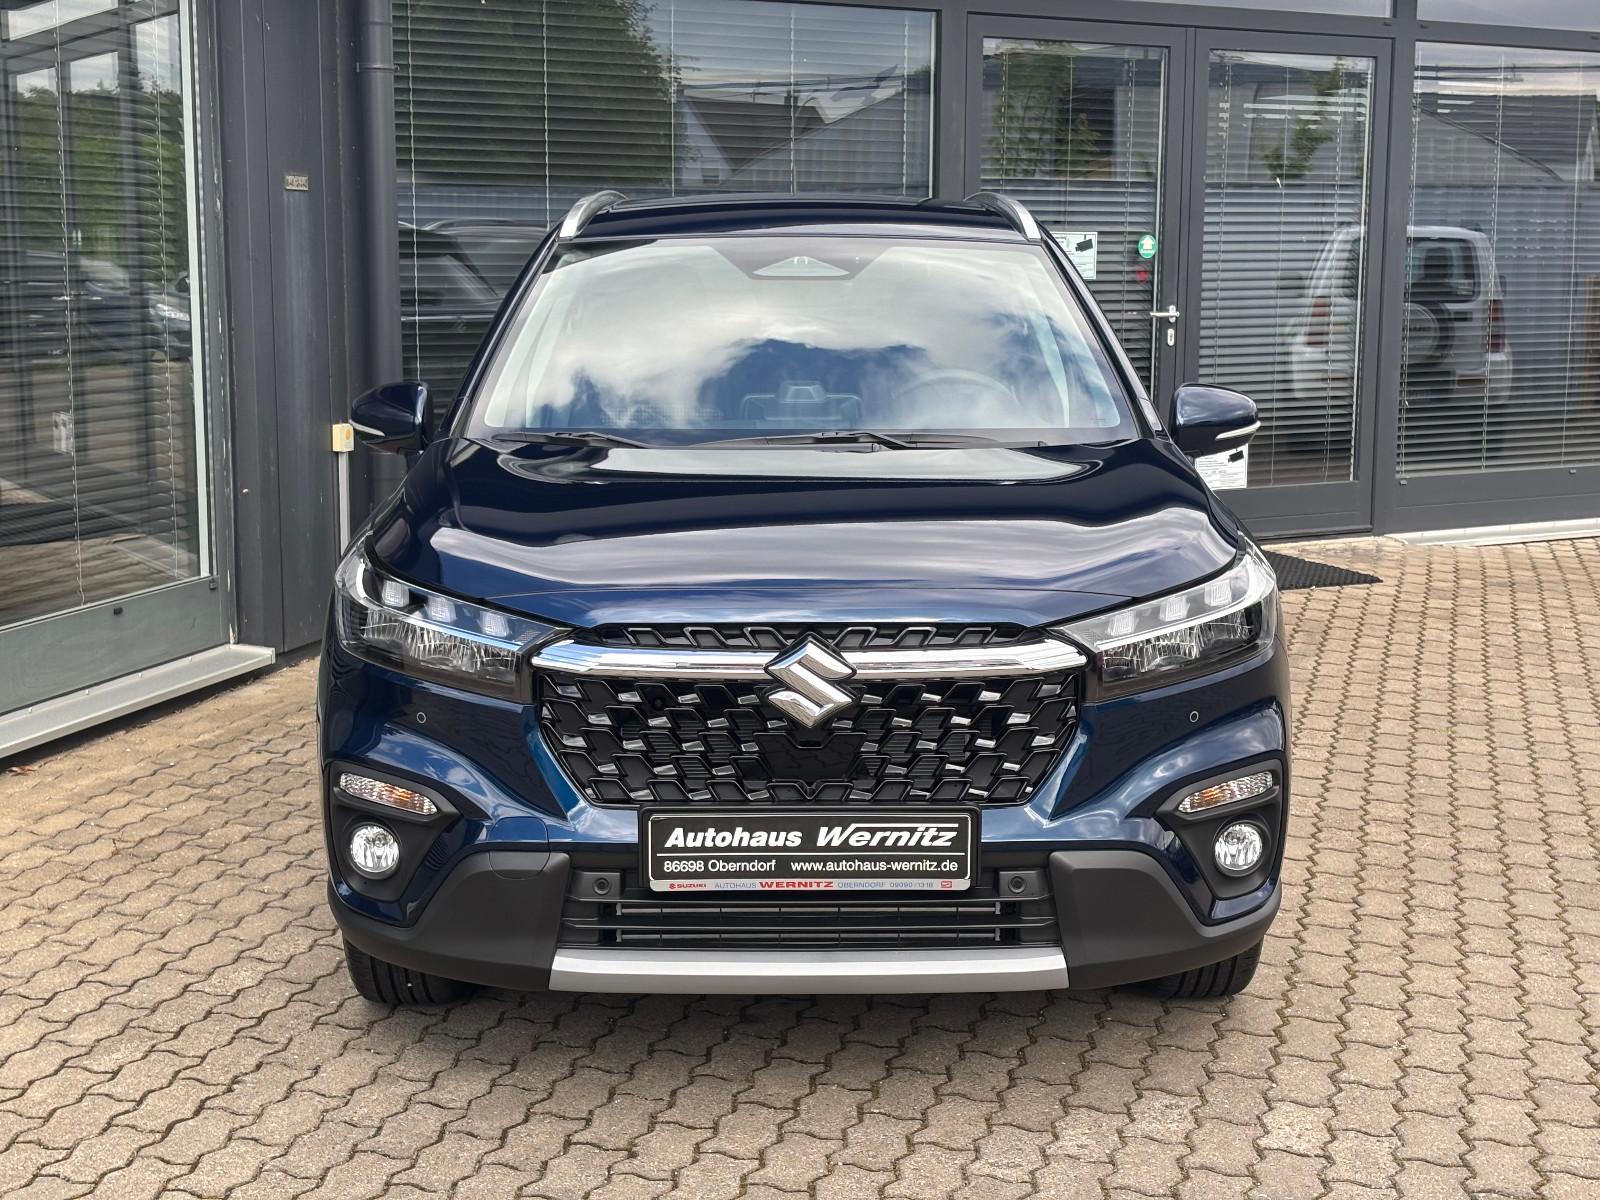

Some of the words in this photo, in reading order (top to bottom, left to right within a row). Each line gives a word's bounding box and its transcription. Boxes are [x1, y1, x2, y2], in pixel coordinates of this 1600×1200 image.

[664, 827, 803, 848] Autohaus
[816, 823, 959, 847] Wernitz
[664, 860, 705, 872] 86698
[708, 859, 776, 872] Oberndorf
[790, 858, 958, 872] www.autohaus-wernitz.de
[714, 880, 757, 889] AUTOHAUS
[759, 880, 834, 889] WERNITZ
[837, 880, 885, 889] OBERNDORF
